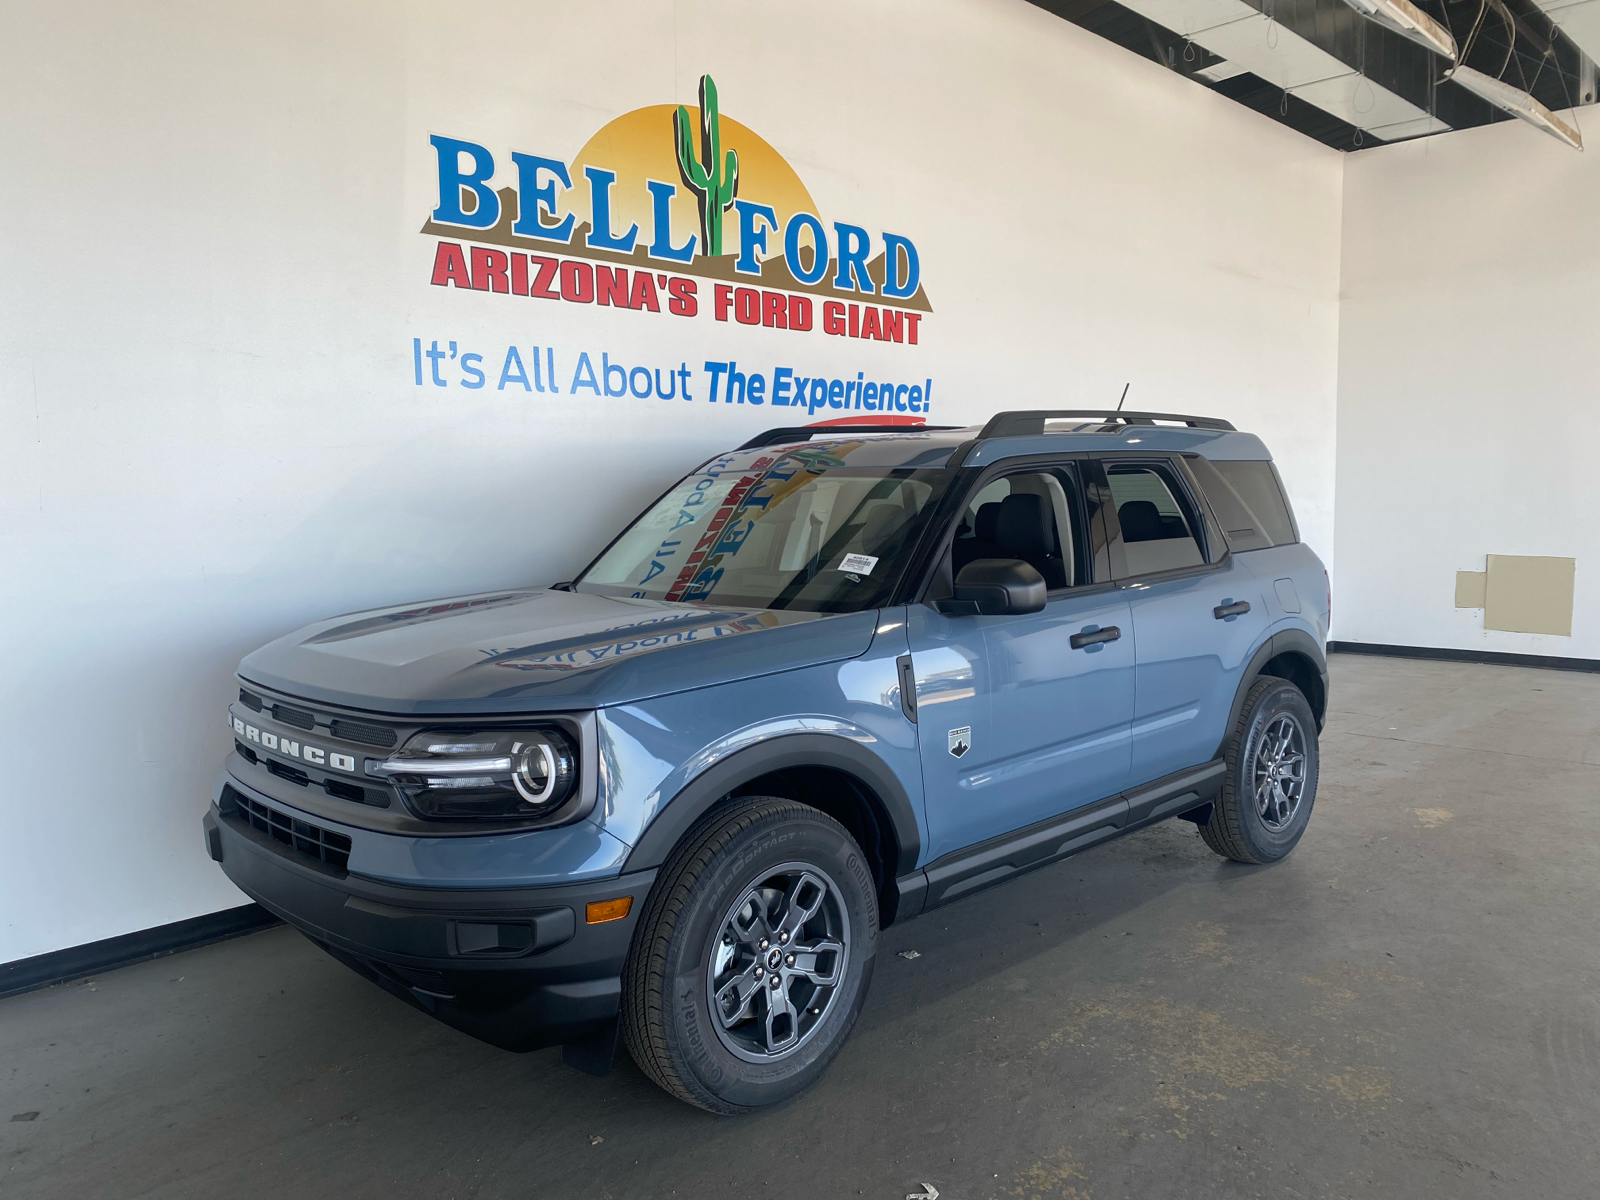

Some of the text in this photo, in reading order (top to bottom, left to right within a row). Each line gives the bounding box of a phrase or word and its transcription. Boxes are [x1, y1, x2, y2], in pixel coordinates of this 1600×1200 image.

[429, 133, 920, 299] BELL FORD
[430, 241, 922, 345] ARIZONA'S FORD GIANT
[497, 345, 559, 393] All
[569, 351, 693, 401] About
[703, 360, 766, 405] The
[771, 366, 932, 415] Experience!
[233, 717, 355, 772] BRONCO
[846, 853, 876, 929] Continental
[681, 1002, 723, 1084] Continental
